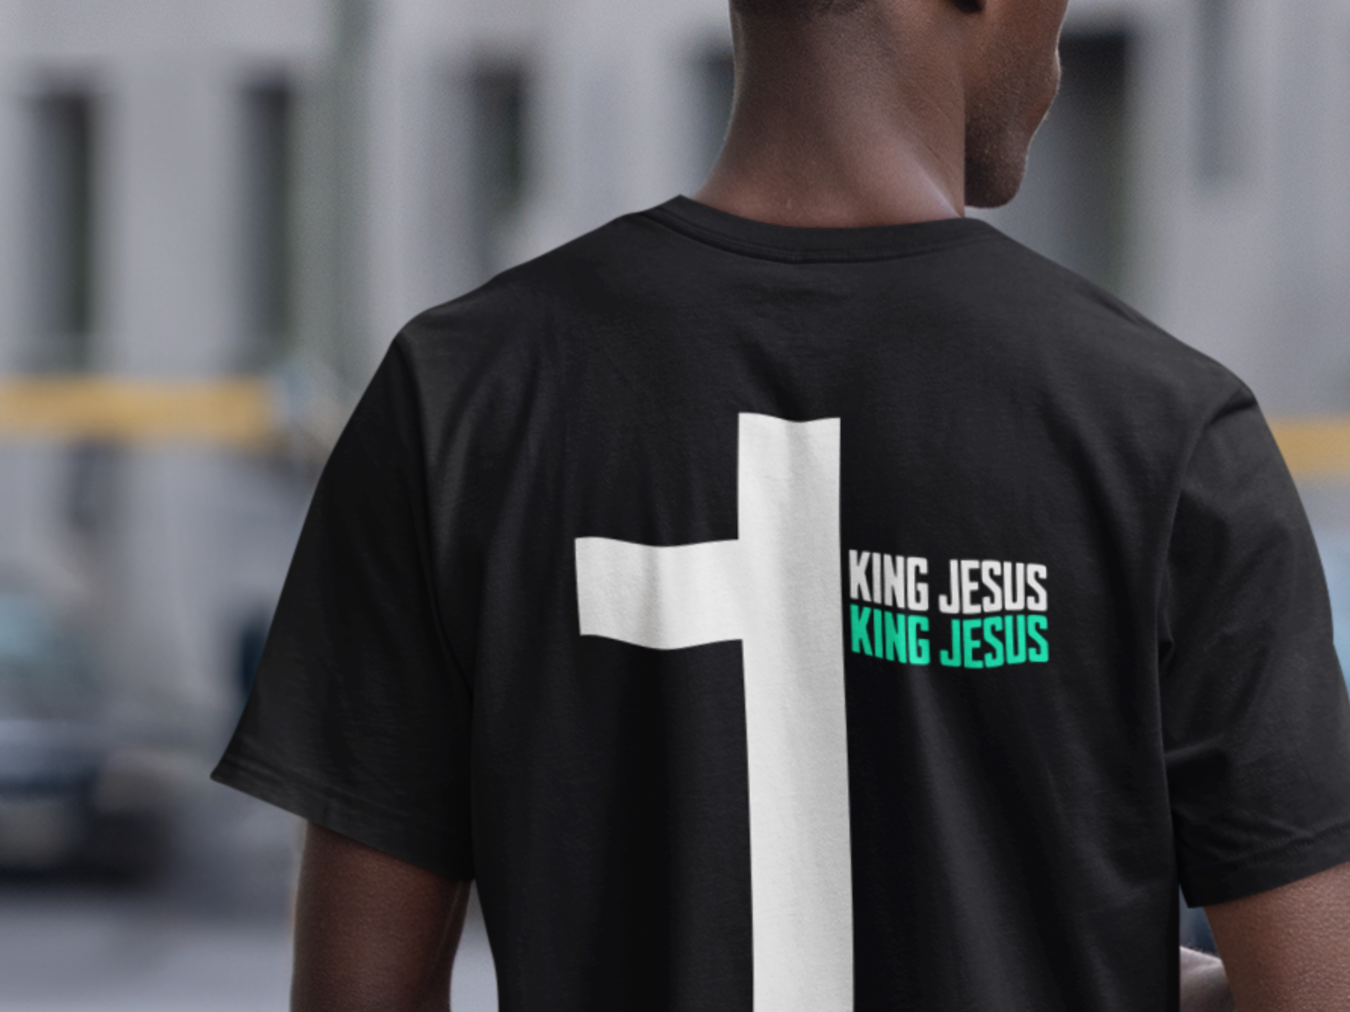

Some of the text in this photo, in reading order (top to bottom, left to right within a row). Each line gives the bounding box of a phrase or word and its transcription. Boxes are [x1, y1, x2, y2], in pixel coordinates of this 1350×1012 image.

[849, 549, 1047, 614] KING JESUS
[850, 603, 1049, 669] KING JESUS
